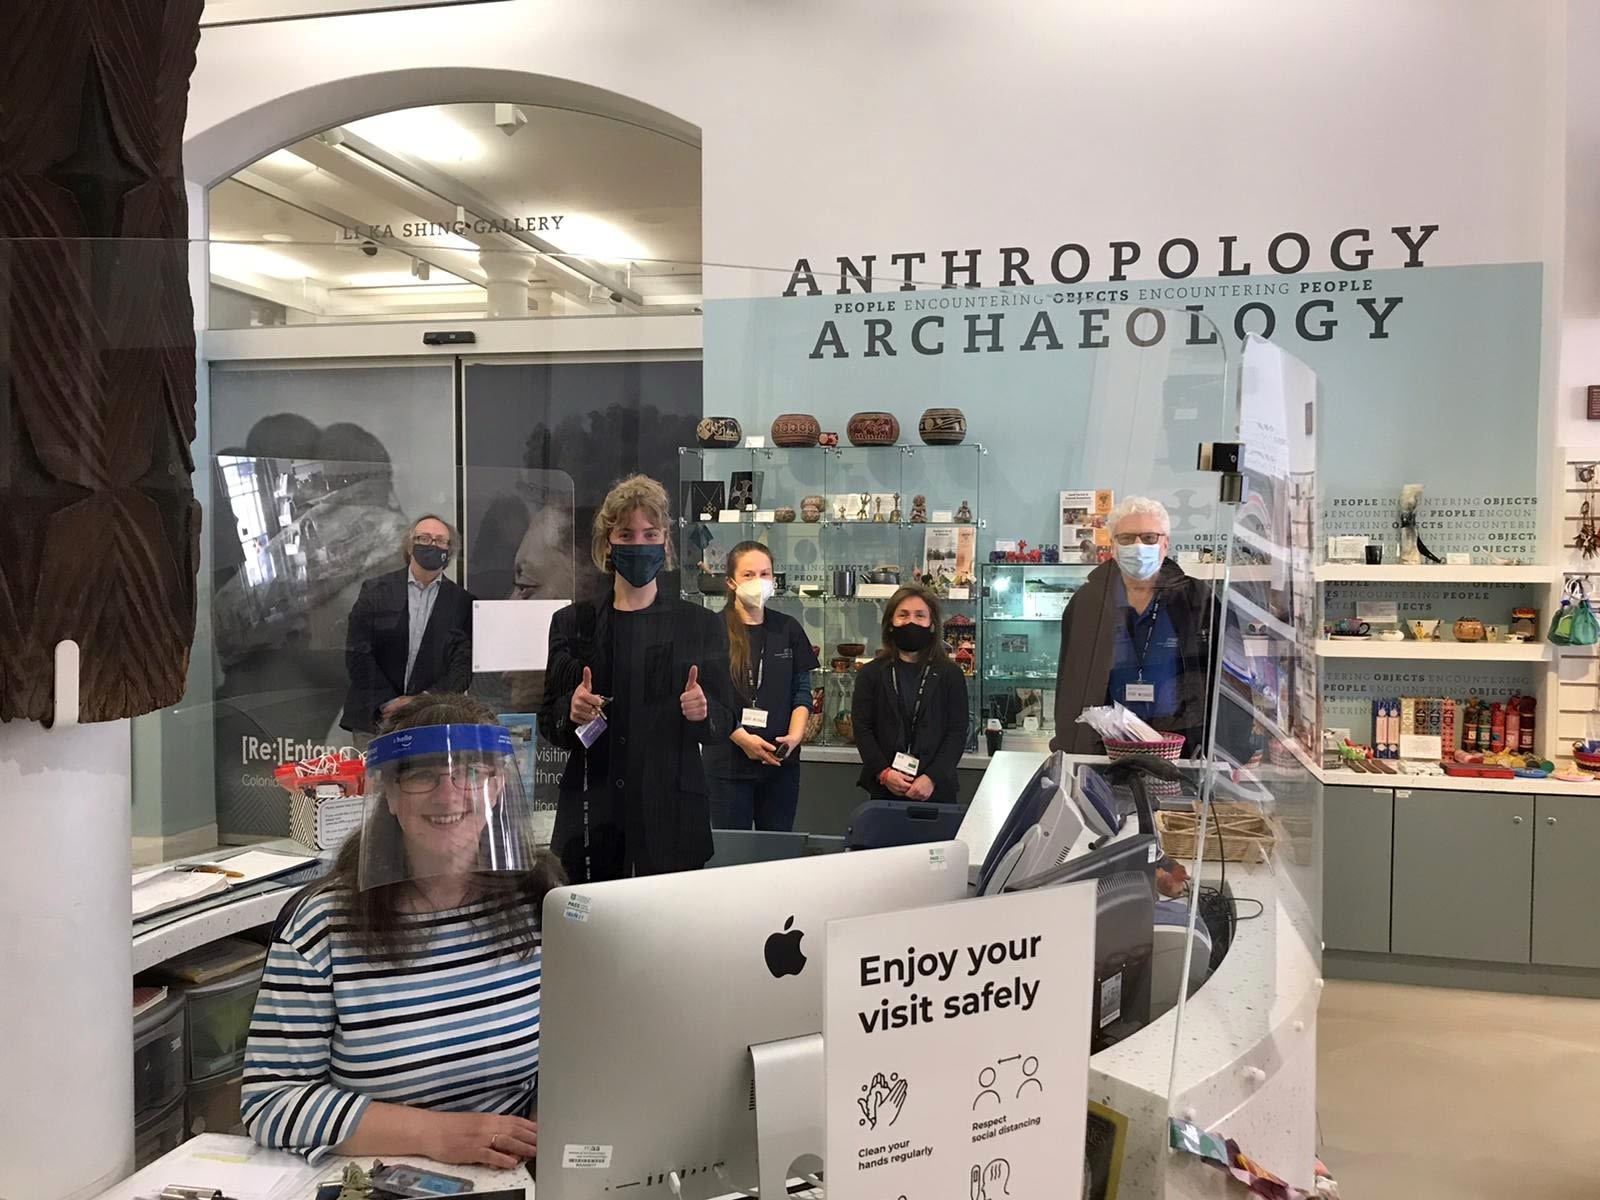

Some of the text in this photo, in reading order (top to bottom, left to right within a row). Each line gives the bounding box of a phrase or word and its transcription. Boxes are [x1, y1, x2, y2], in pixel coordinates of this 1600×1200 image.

[342, 215, 565, 241] LI KA SHING GALLERY
[782, 224, 1439, 297] ANTHROPOLOGY
[834, 279, 1373, 314] PEOPLE ENCOUNTERING OBJECTS ENCOUNTERING PEOPLE
[809, 297, 1403, 359] ARCHAEOLOGY
[1333, 498, 1379, 507] PEOPLE
[1483, 497, 1537, 506] OBJECTS
[1430, 509, 1476, 518] PEOPLE
[1479, 509, 1536, 518] ENCOUN
[1442, 591, 1490, 600] PEOPLE
[1323, 683, 1367, 692] PEOPLE
[1469, 687, 1522, 696] OBJECTS
[1373, 673, 1425, 682] OBJECTS
[860, 935, 1042, 987] Enjoy your
[858, 976, 1041, 1034] visit safely
[971, 1115, 1042, 1143] social distancing
[972, 1115, 1008, 1132] Respect
[858, 1139, 911, 1159] Clean your
[858, 1145, 934, 1171] hands regularly
